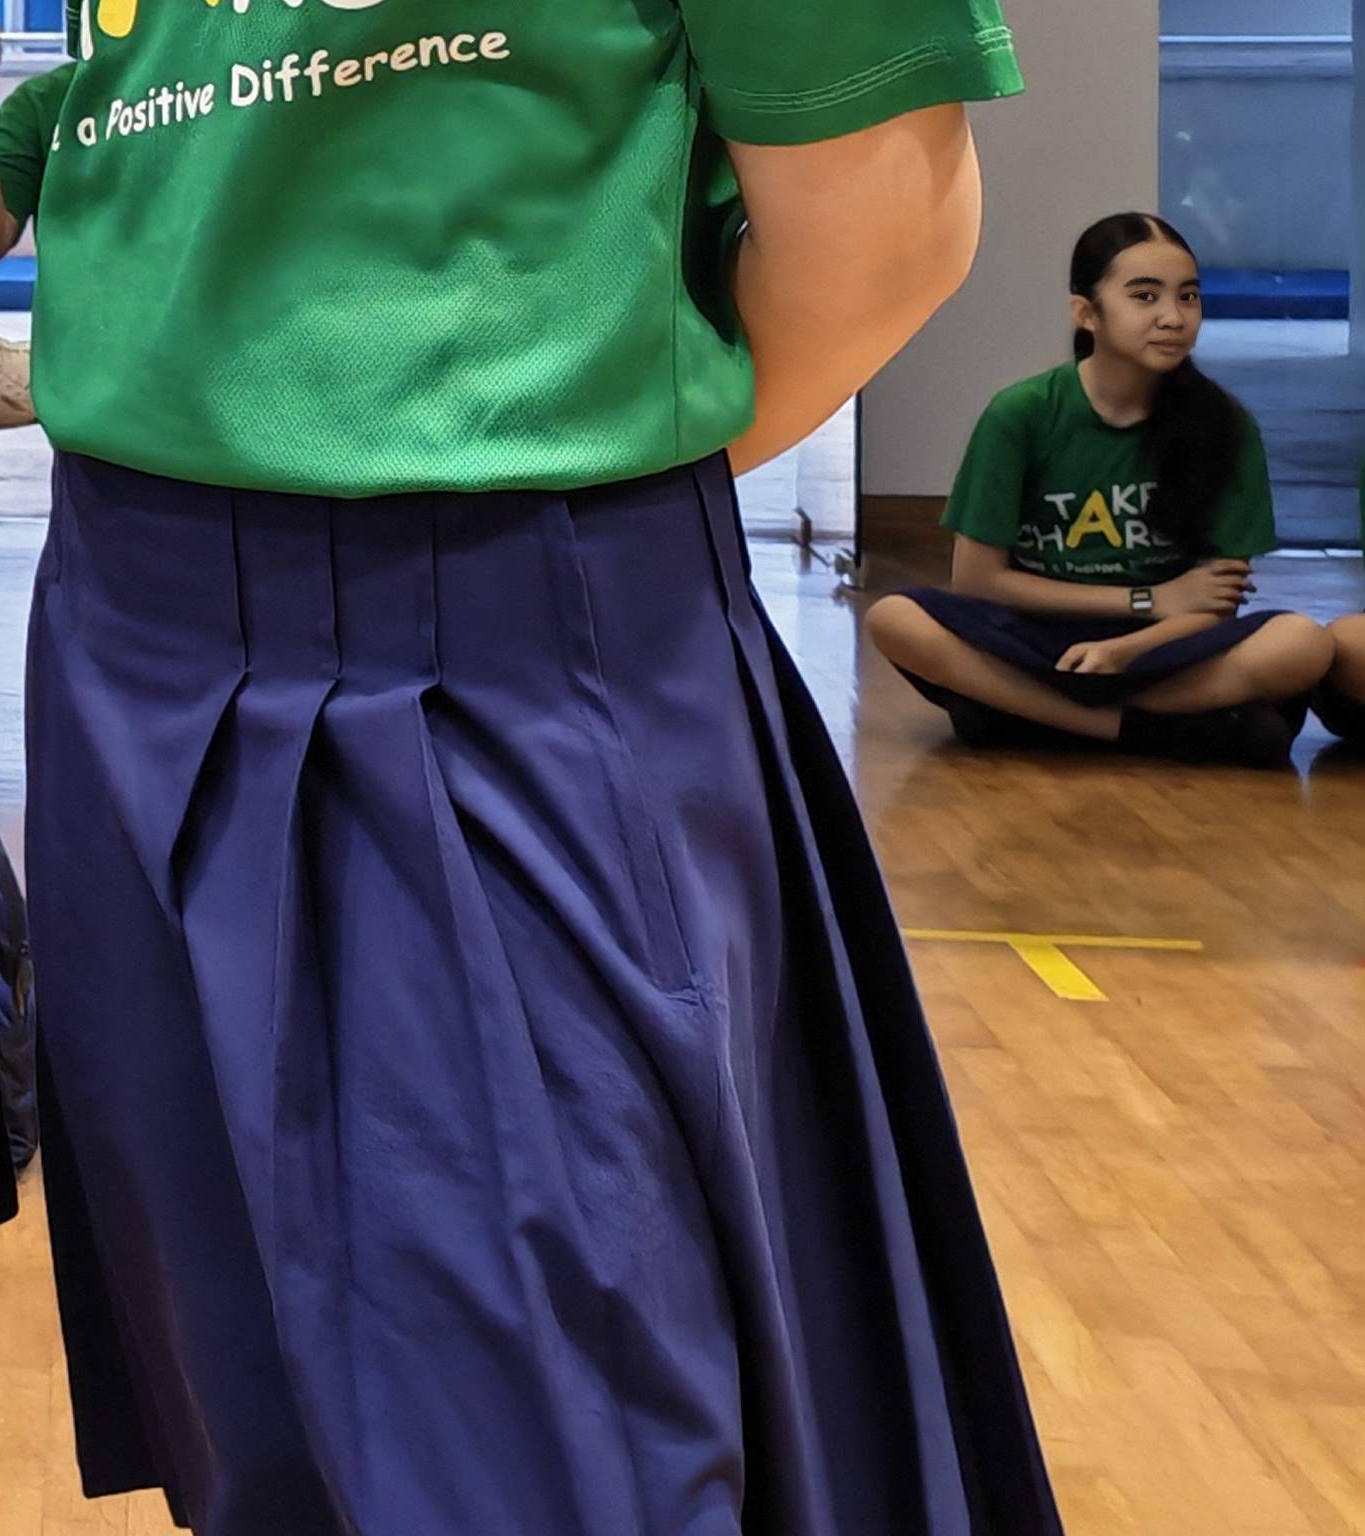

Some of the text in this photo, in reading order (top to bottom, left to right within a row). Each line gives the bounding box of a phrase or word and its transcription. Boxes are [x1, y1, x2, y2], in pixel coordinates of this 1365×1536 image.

[77, 116, 97, 146] a
[105, 82, 215, 140] Positive
[231, 31, 510, 107] Difference
